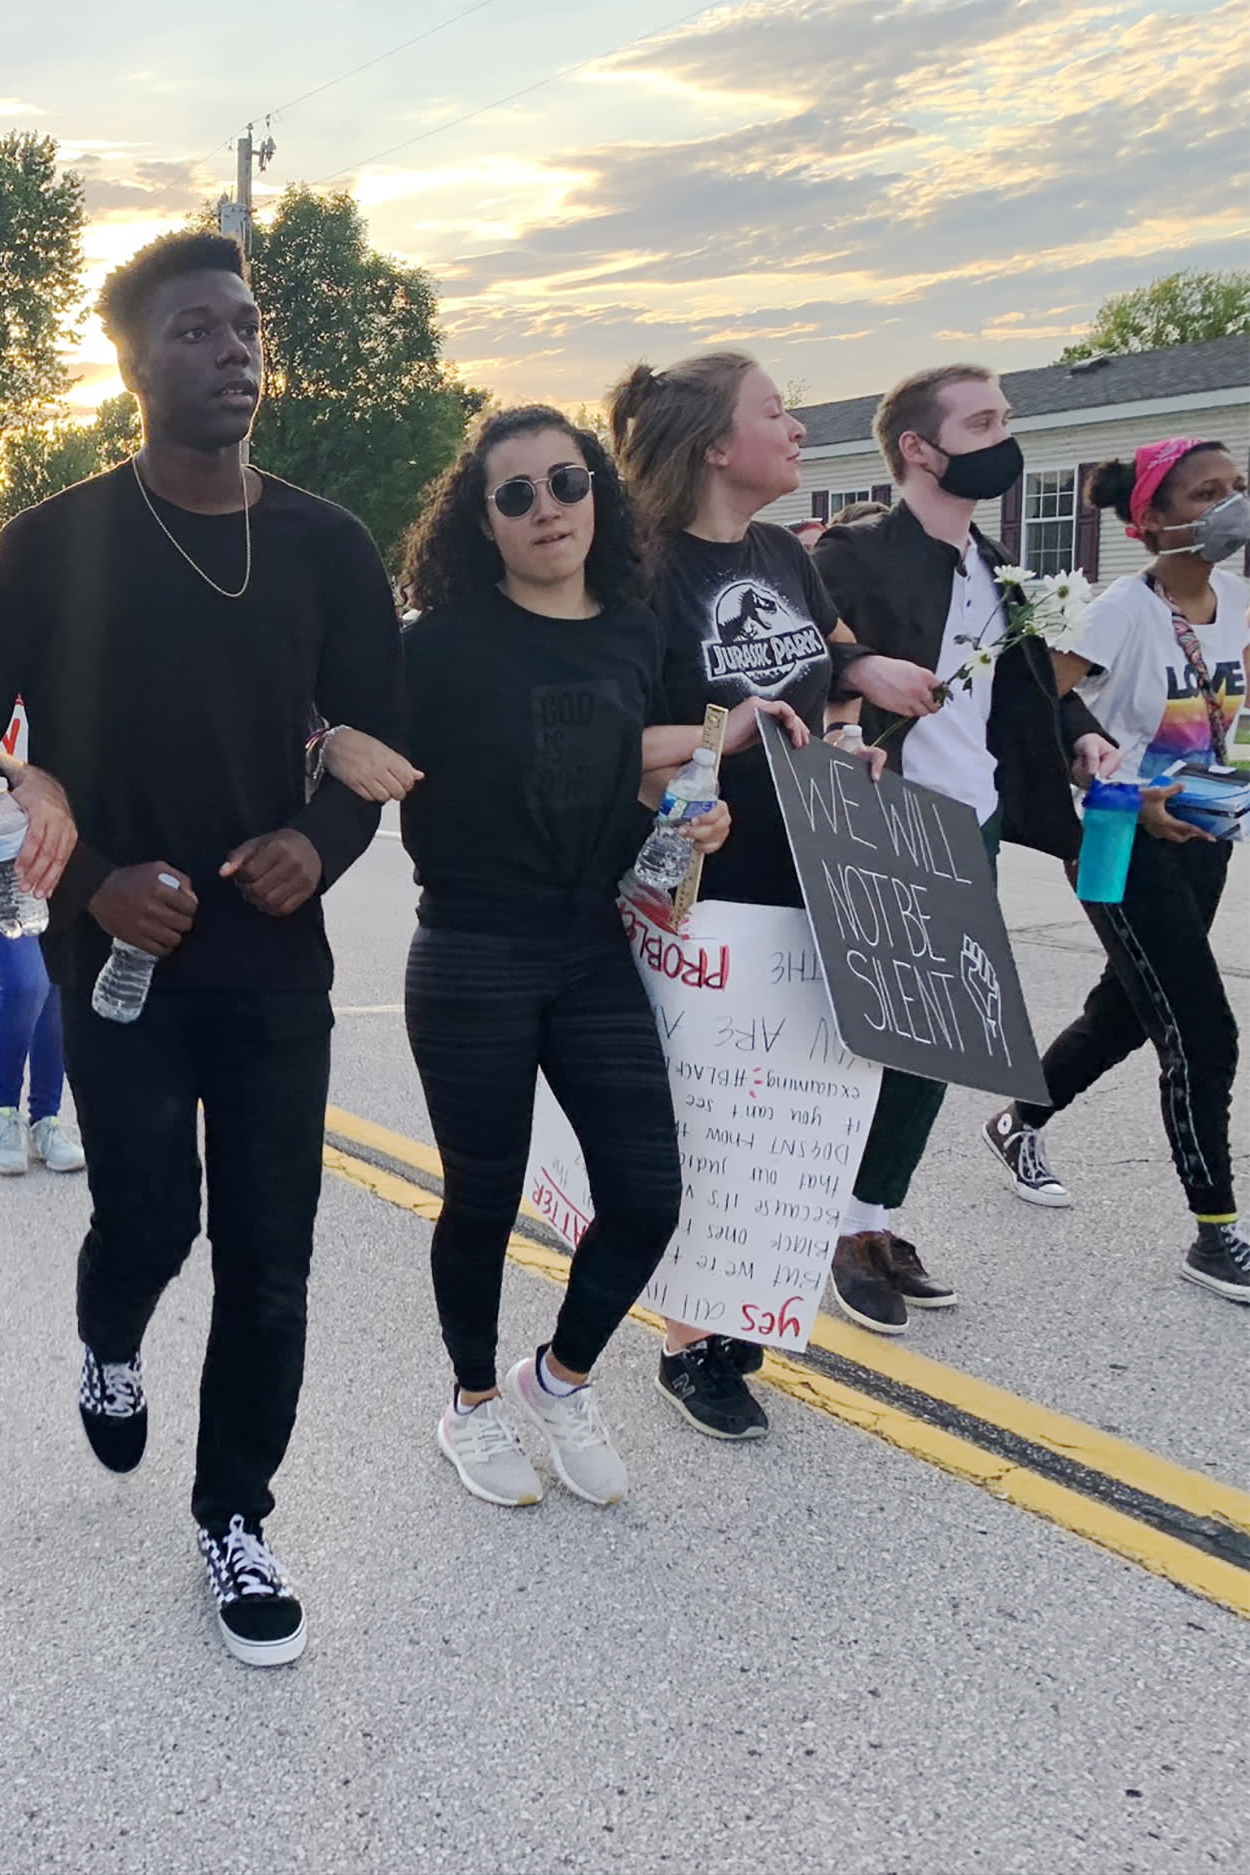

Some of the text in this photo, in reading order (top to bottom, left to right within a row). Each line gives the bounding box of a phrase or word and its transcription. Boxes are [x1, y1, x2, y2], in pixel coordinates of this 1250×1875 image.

[713, 629, 822, 676] JURASSIC PARK
[776, 728, 972, 884] WE WILL
[822, 859, 946, 962] NOT BE
[620, 902, 730, 991] PROBLE
[846, 949, 965, 1053] SILENT
[714, 1016, 787, 1053] ARE
[686, 1094, 715, 1113] see
[790, 1105, 822, 1127] you
[532, 1175, 587, 1248] ATTER
[681, 1293, 725, 1321] all
[741, 1296, 804, 1337] yes
